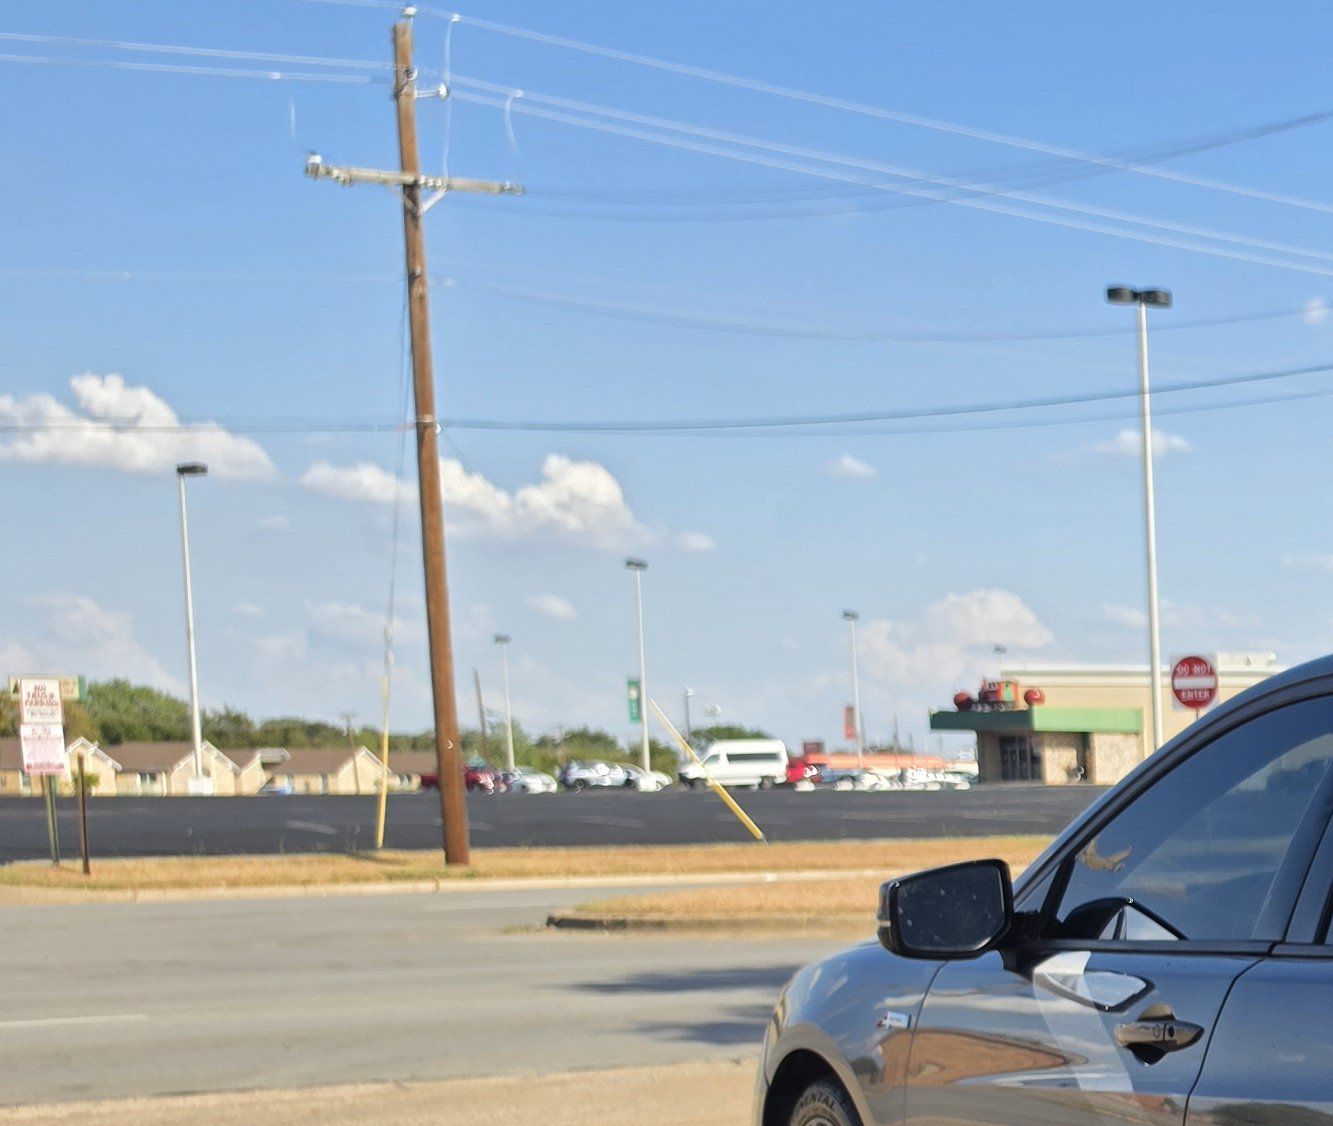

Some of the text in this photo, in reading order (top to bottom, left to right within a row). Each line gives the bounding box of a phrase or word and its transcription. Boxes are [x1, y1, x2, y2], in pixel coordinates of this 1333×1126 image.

[1176, 662, 1212, 676] DO NOT
[1181, 688, 1210, 702] ENTER
